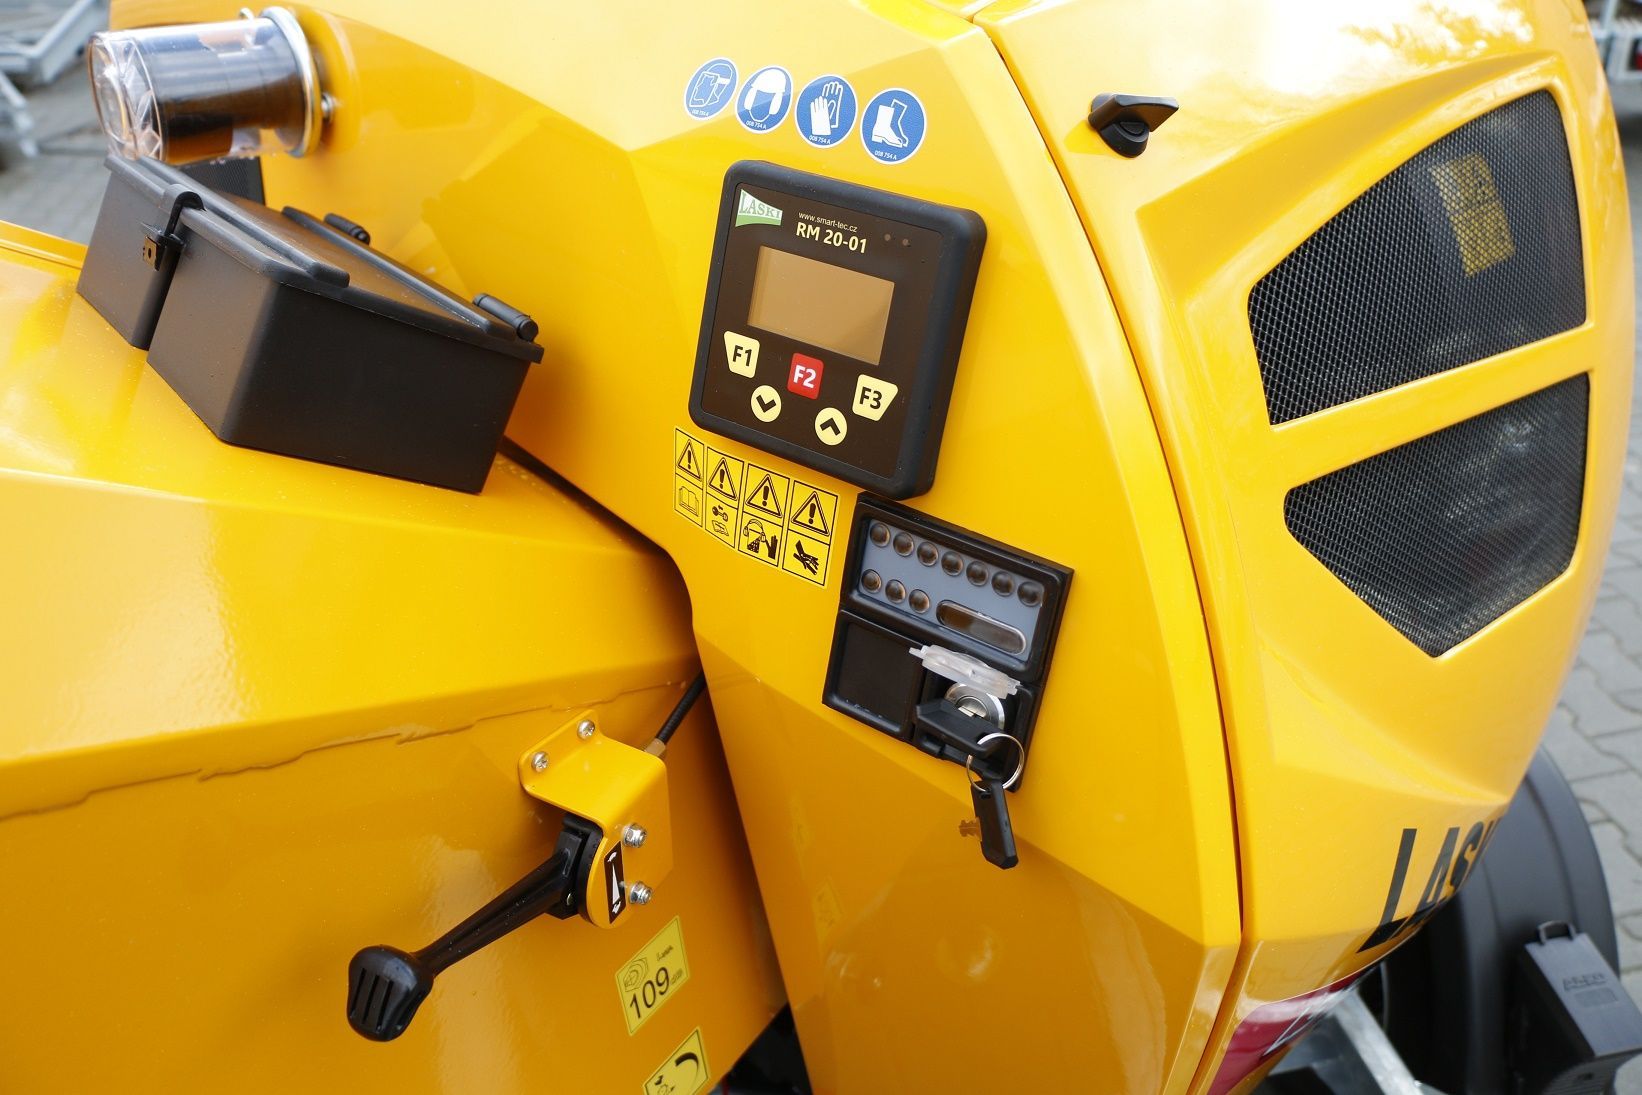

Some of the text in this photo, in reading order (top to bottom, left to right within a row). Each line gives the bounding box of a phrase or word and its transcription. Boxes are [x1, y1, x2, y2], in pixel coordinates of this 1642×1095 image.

[739, 192, 781, 219] LASKI
[798, 211, 858, 233] www.smart-tec.cz
[796, 221, 867, 254] RM 20-01
[731, 344, 752, 367] F1
[793, 364, 817, 388] F2
[859, 386, 883, 410] F3
[629, 966, 671, 1018] 109
